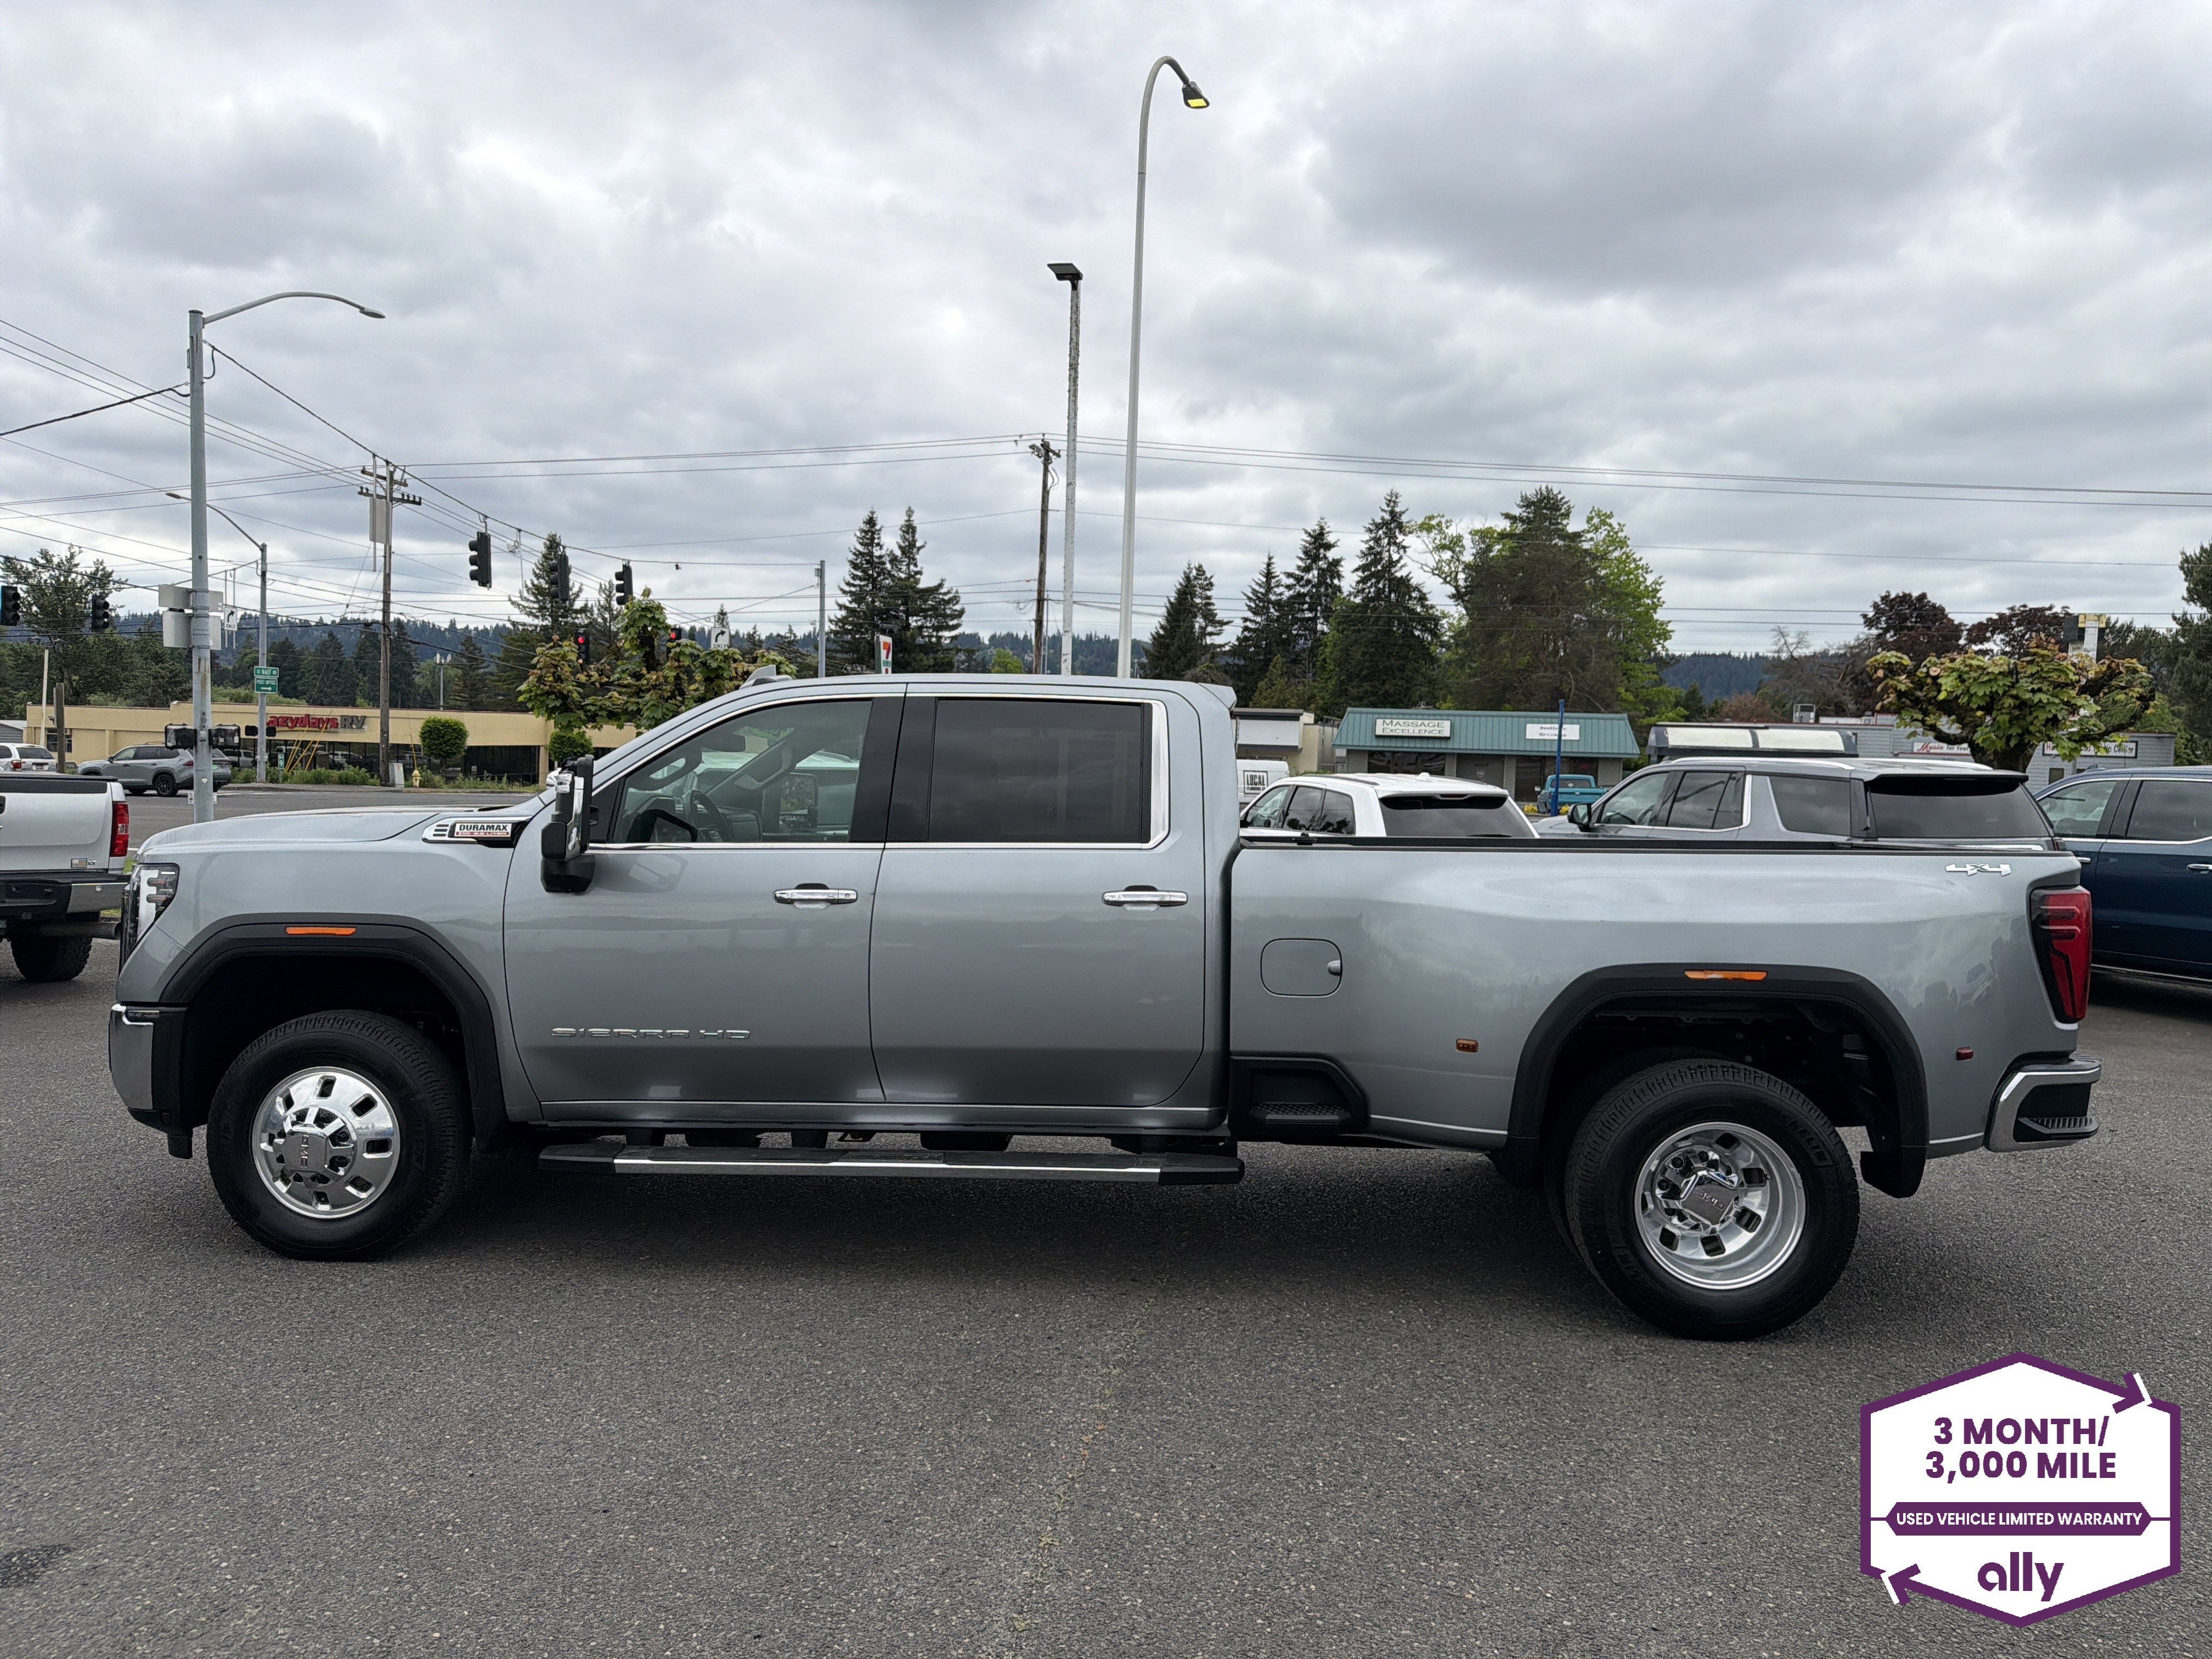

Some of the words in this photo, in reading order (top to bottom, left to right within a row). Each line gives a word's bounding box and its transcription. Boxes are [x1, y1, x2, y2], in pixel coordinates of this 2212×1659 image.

[266, 714, 339, 730] azydays
[340, 715, 366, 730] RV
[1382, 720, 1445, 728] MASSAGE
[1246, 774, 1266, 786] LOCAL
[552, 1028, 690, 1039] SIERRA
[699, 1029, 750, 1039] HD
